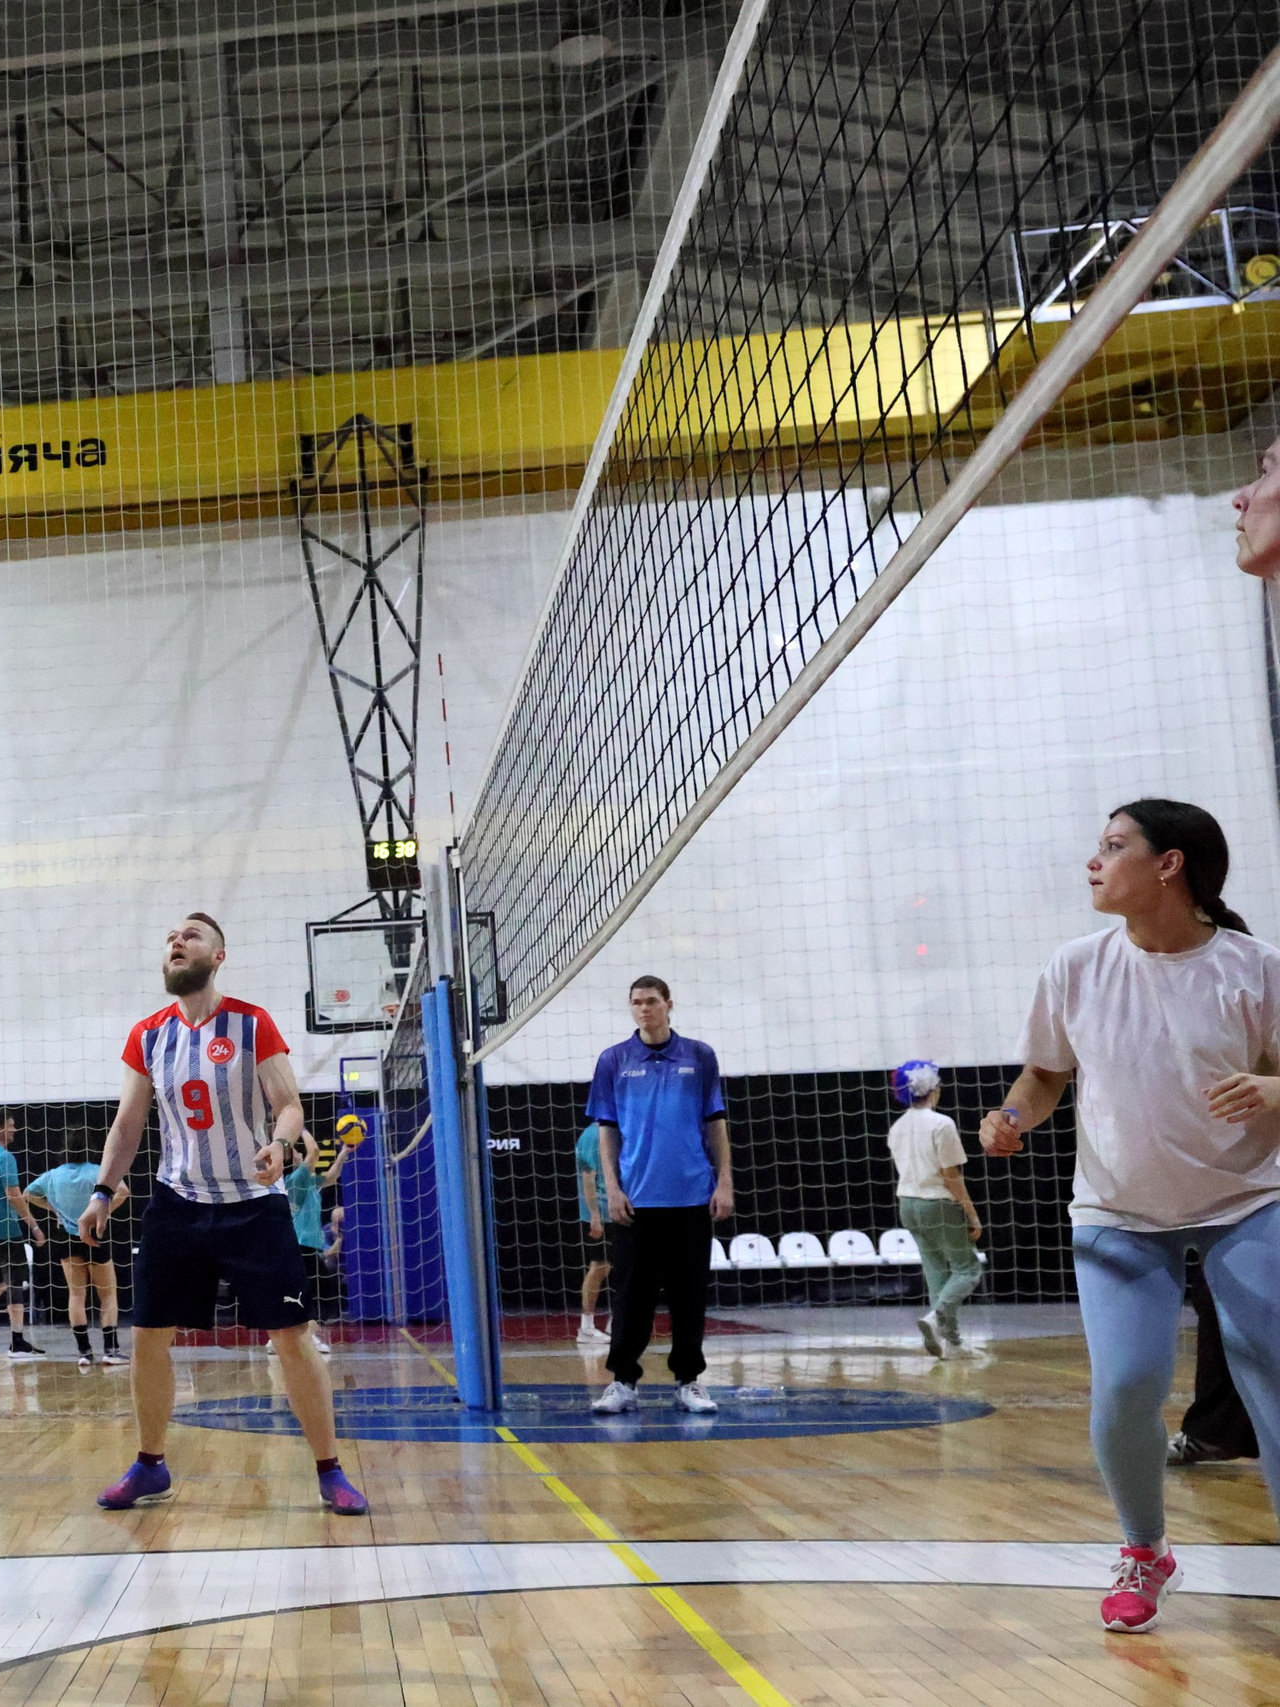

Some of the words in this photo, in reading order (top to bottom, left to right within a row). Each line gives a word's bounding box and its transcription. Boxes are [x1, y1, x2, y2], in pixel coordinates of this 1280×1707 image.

[395, 840, 416, 858] 38
[211, 1044, 229, 1056] 24
[181, 1079, 214, 1131] 9
